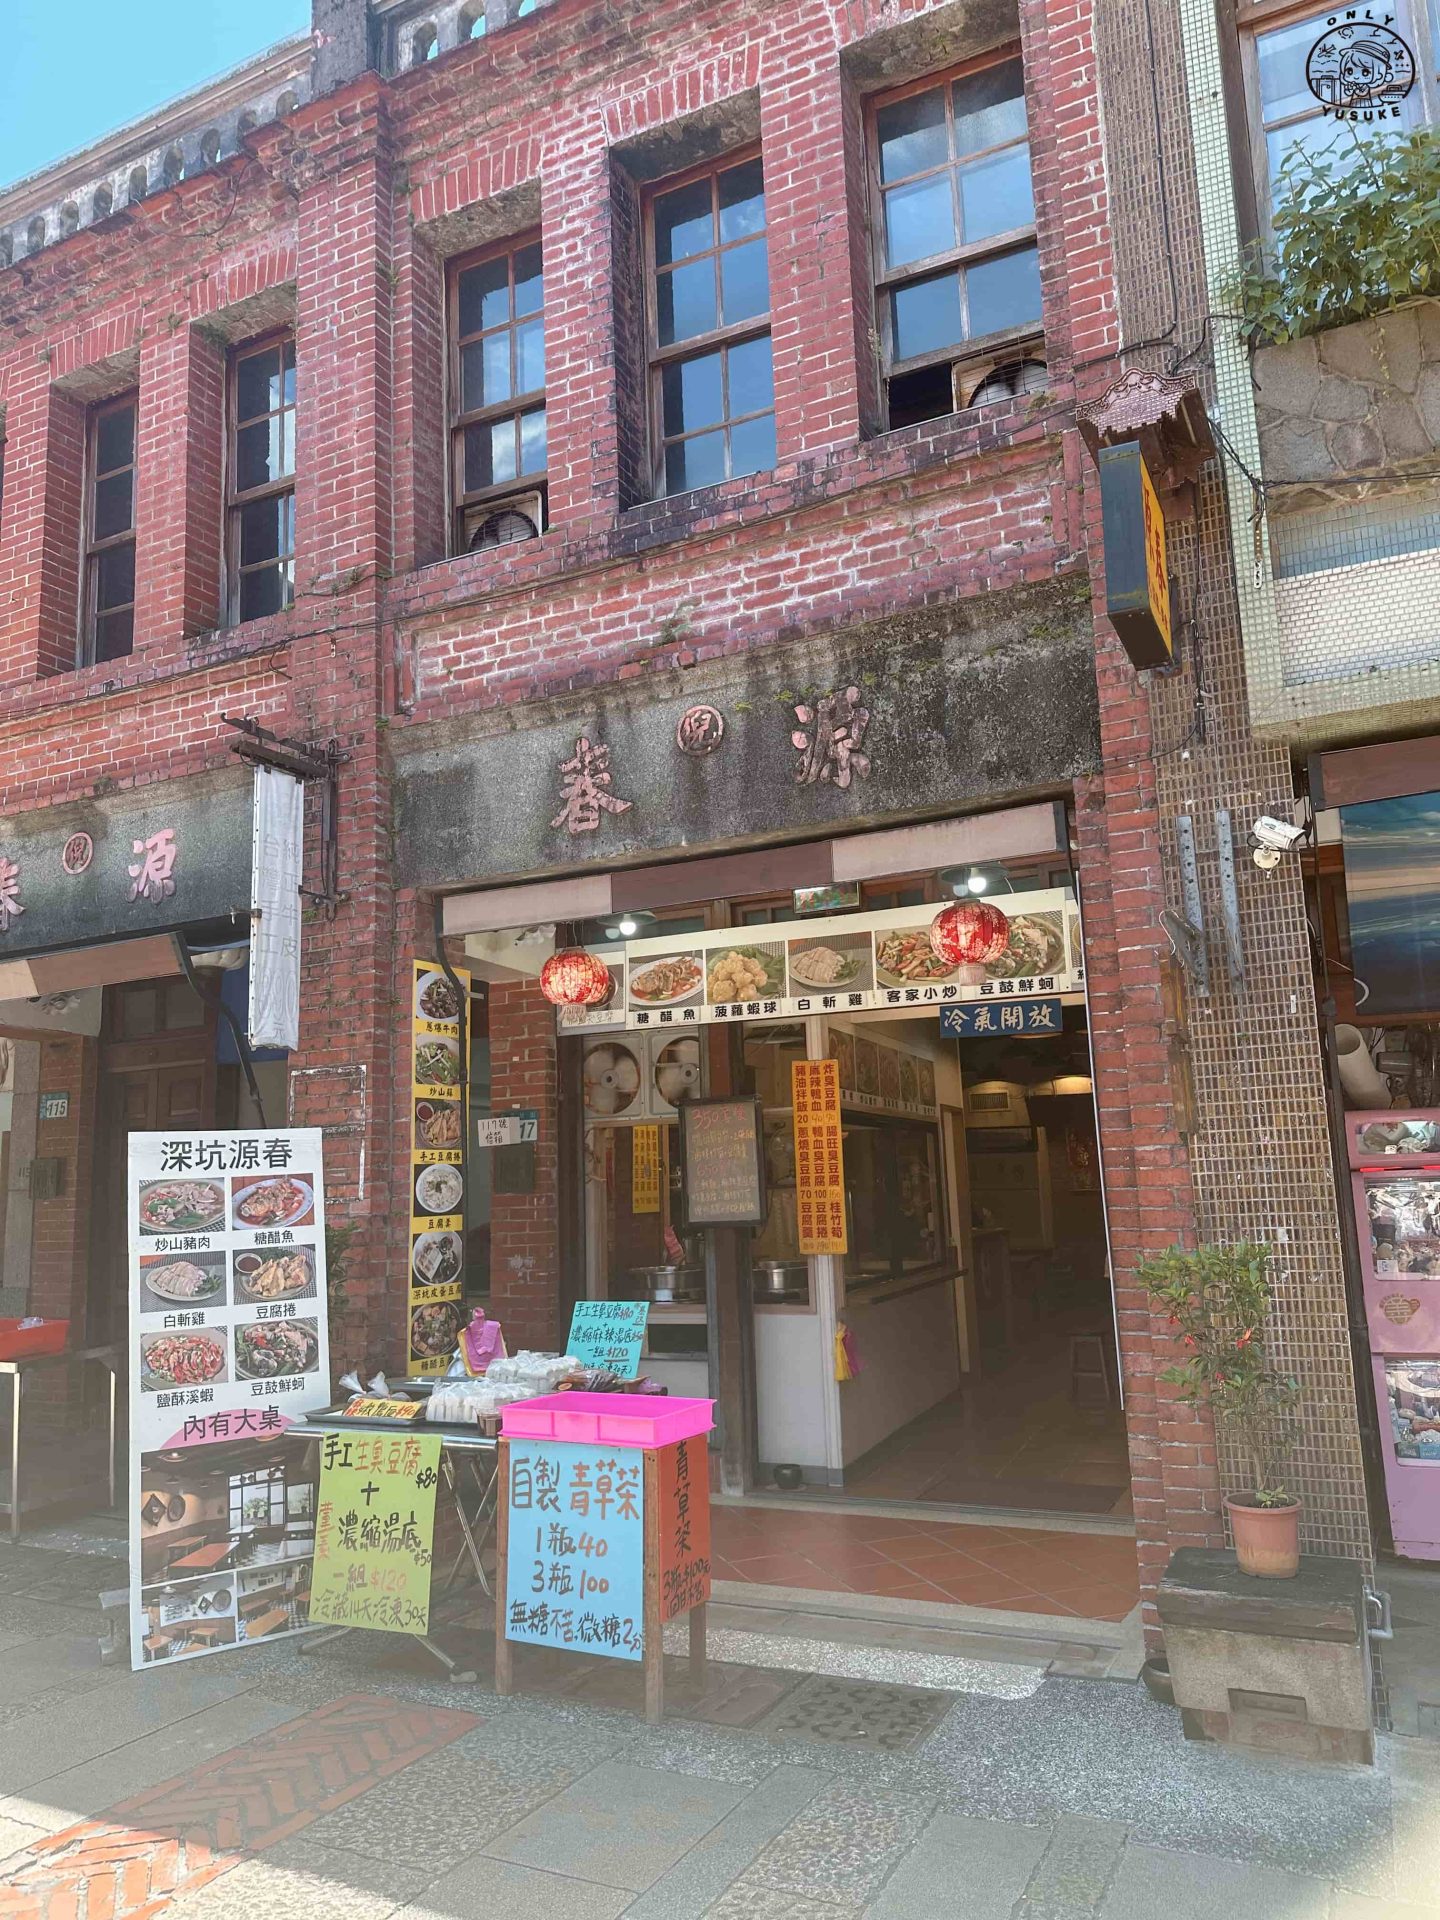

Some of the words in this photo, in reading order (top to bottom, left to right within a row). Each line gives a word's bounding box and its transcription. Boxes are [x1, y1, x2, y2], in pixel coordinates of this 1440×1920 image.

[549, 736, 635, 835] 春
[791, 686, 872, 789] 源
[127, 828, 178, 906] 源
[636, 1008, 696, 1025] 糖醋魚
[714, 1000, 778, 1018] 菠蘿蝦球
[797, 993, 864, 1011] 白斬雞
[886, 983, 958, 1004] 客家小炒
[944, 1003, 1056, 1033] 冷氣開放
[48, 1101, 67, 1117] 115
[797, 1114, 809, 1124] 20
[160, 1137, 293, 1172] 深坑源春
[812, 1126, 826, 1187] 鴨血臭豆腐
[800, 1190, 812, 1199] 70
[814, 1189, 827, 1199] 100
[830, 1201, 843, 1239] 桂竹筍
[154, 1235, 211, 1252] 炒山豬肉
[254, 1229, 295, 1245] 糖醋魚
[163, 1313, 206, 1328] 白斬雞
[256, 1302, 297, 1320] 豆腐捲
[156, 1387, 214, 1409] 鹽酥溪蝦
[415, 1466, 437, 1489] $80
[673, 1440, 692, 1559] 青草茶
